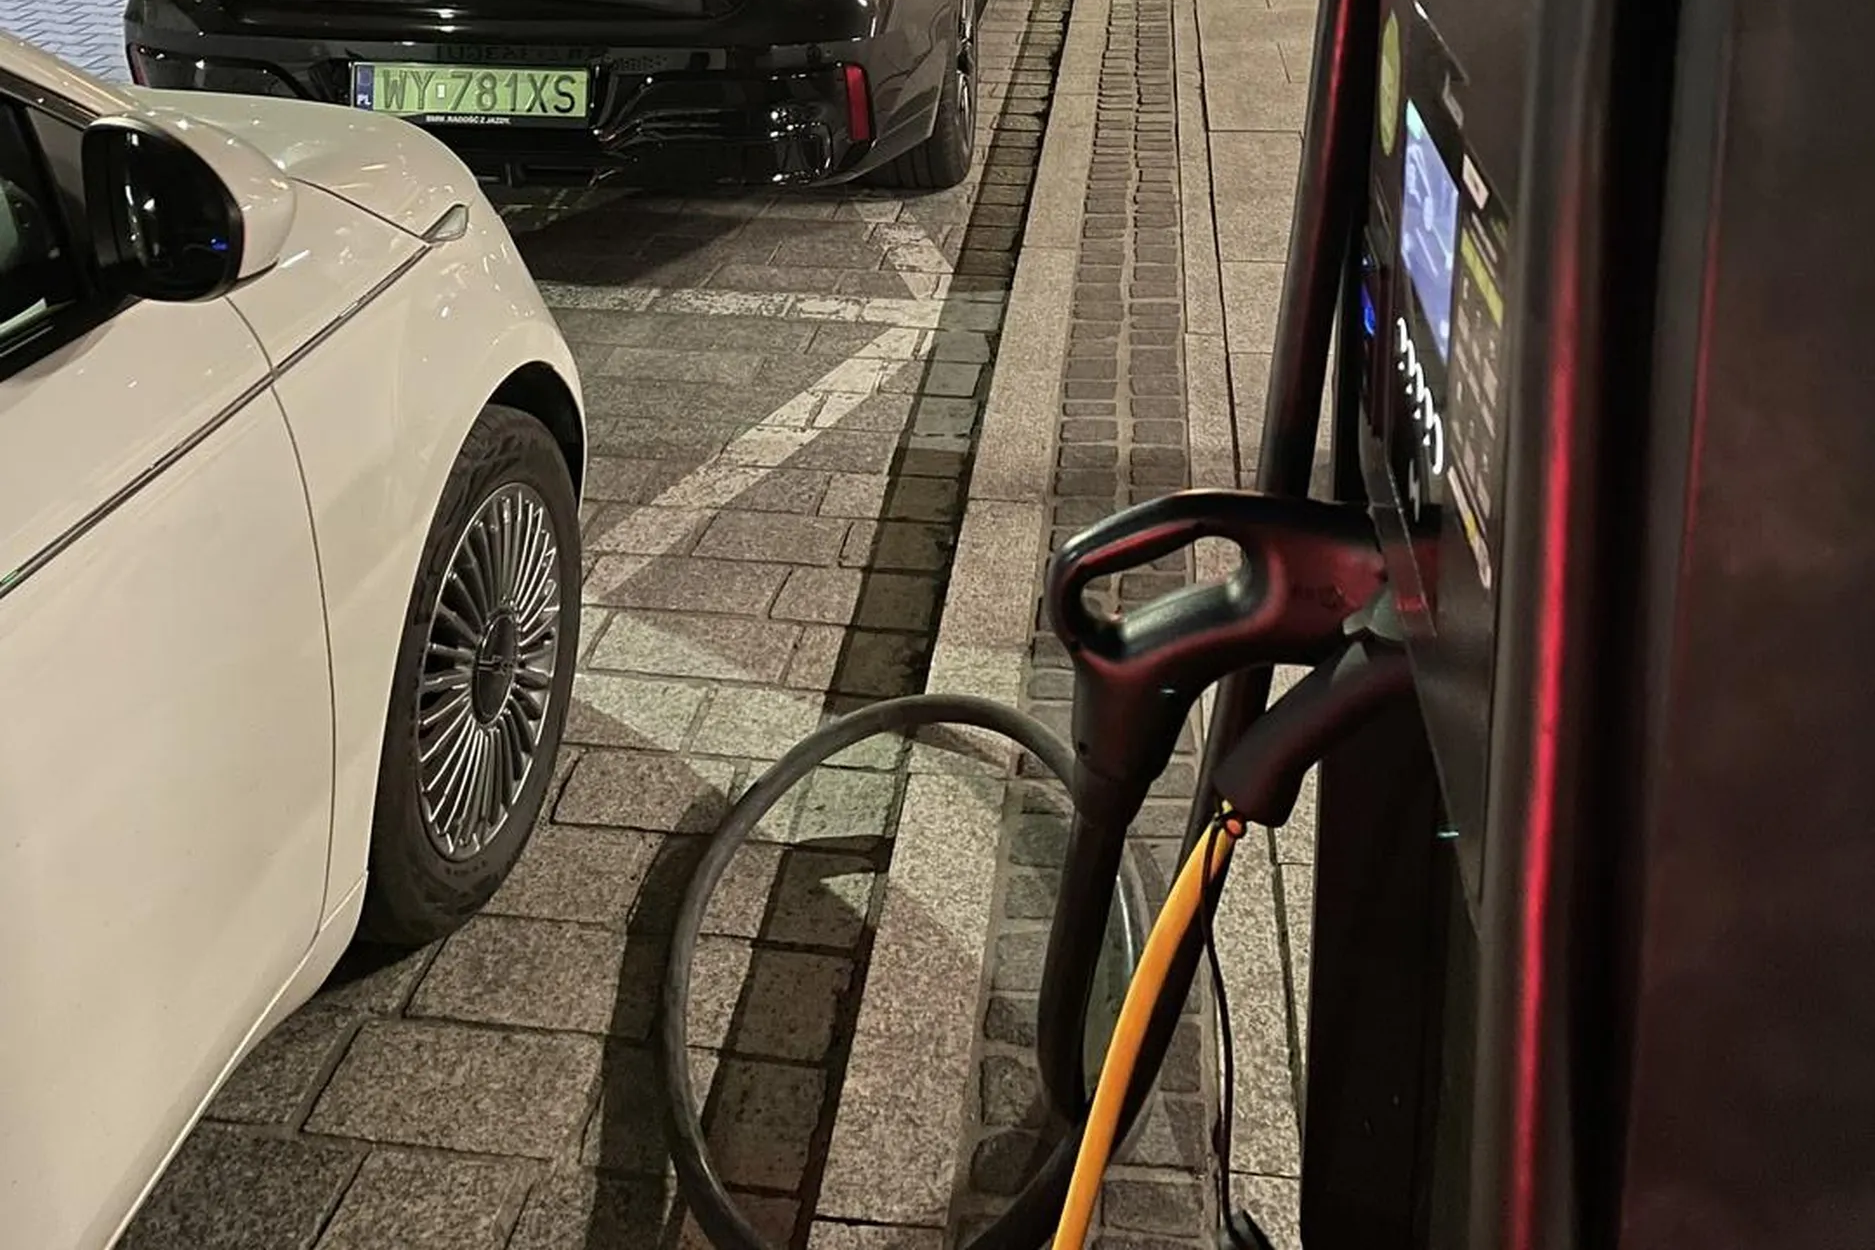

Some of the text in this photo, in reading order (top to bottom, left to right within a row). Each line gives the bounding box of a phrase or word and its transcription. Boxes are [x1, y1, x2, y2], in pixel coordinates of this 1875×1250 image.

[357, 94, 371, 105] PL
[383, 70, 577, 113] WY 781XS
